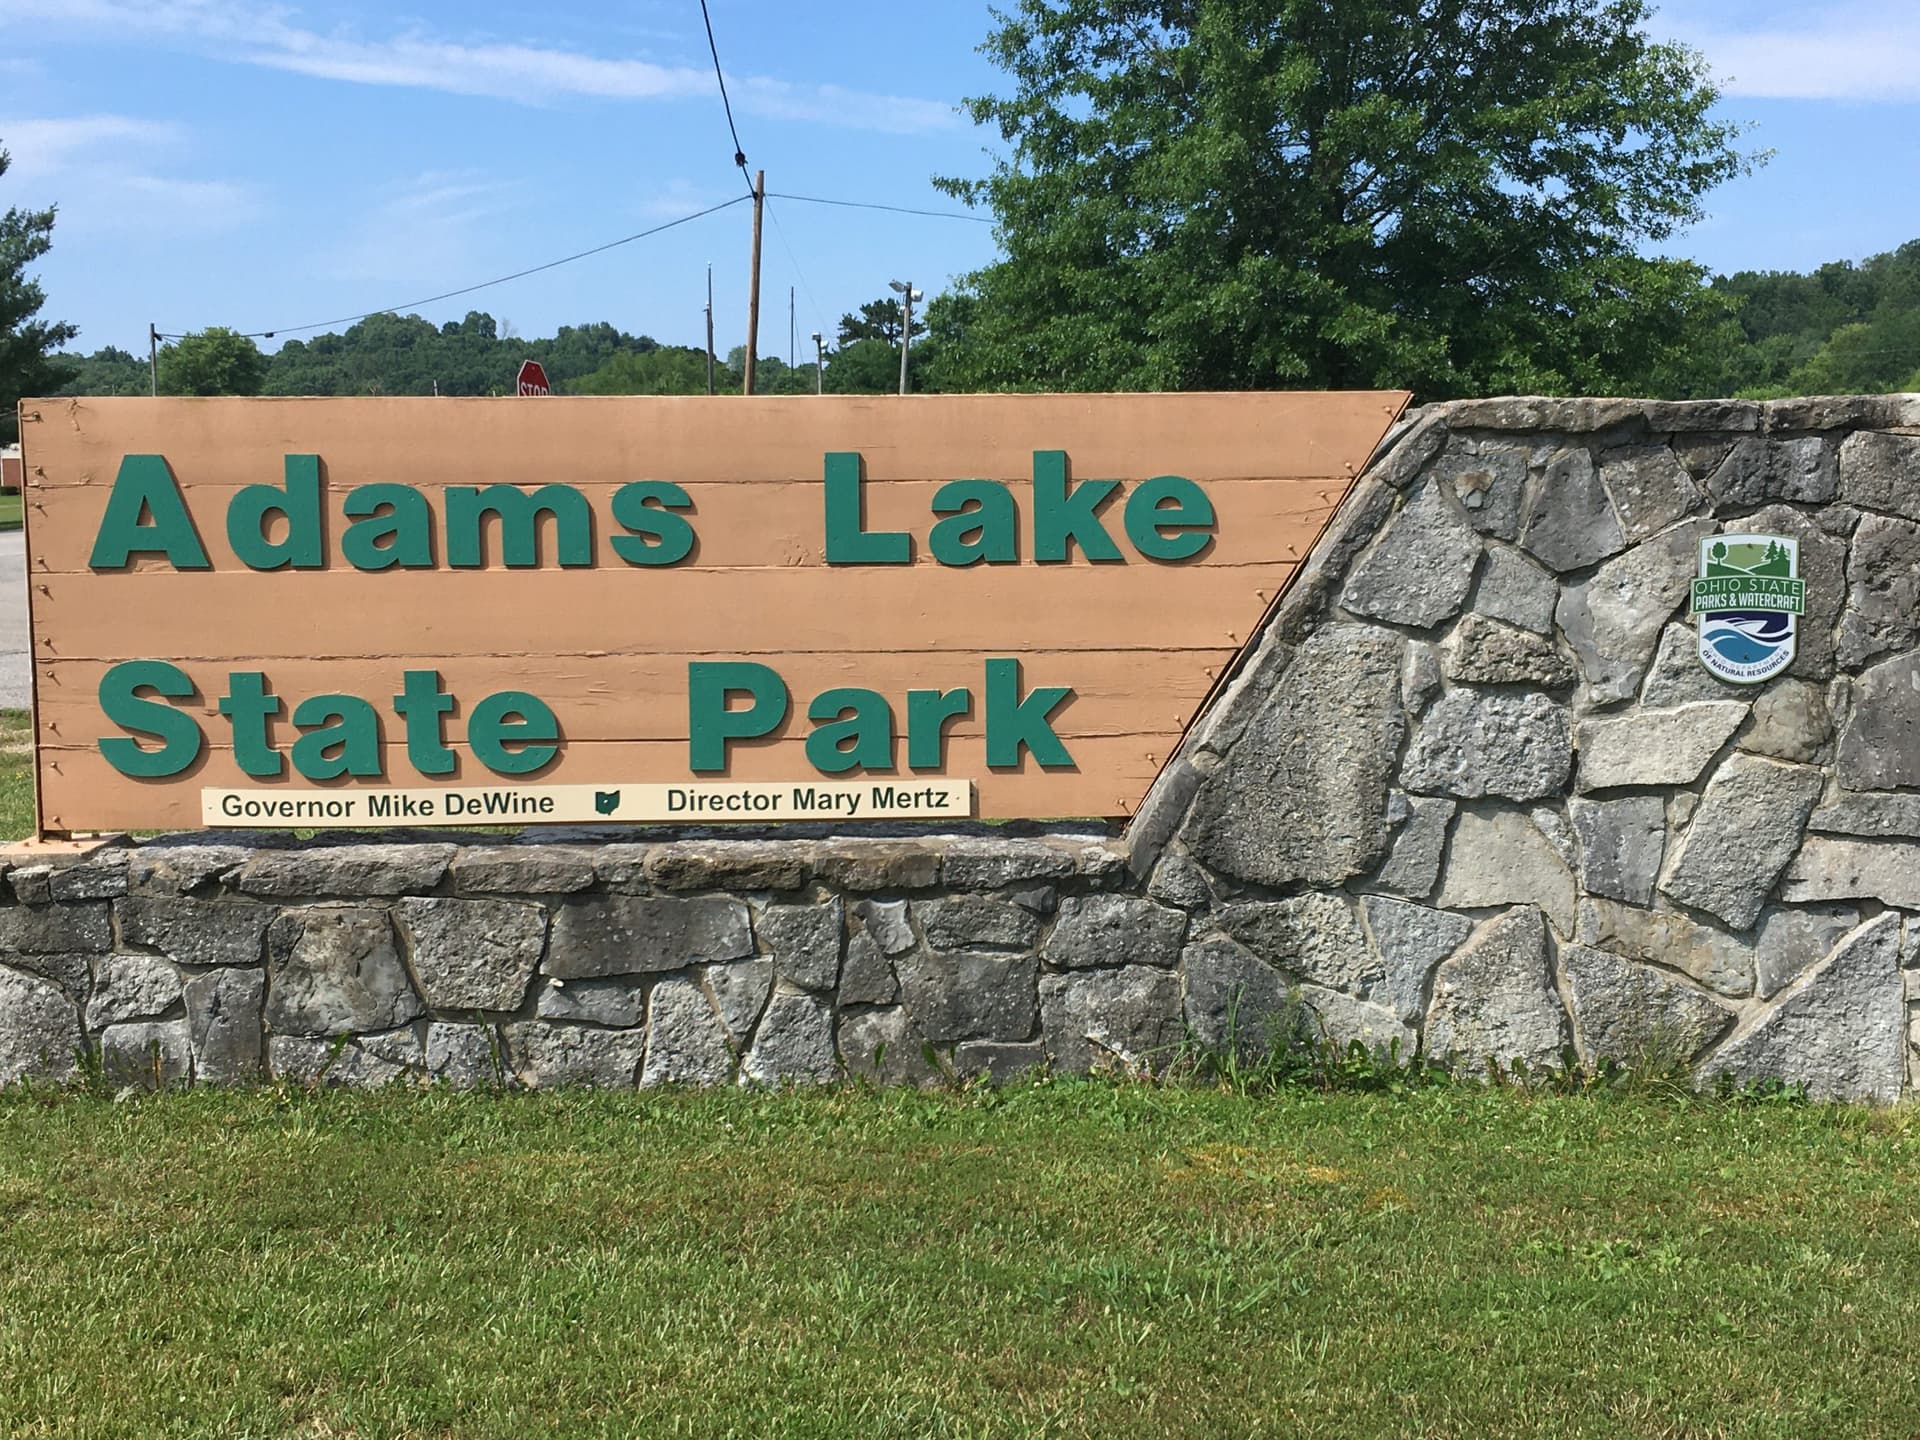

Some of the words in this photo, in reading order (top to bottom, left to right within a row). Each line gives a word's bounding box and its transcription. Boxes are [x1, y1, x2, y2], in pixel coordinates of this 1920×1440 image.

[89, 453, 695, 570] Adams
[824, 449, 1214, 567] Lake
[1695, 578, 1741, 594] OHIO
[1749, 578, 1800, 595] STATE
[1695, 594, 1727, 611] PARKS
[1729, 592, 1737, 607] &
[1738, 593, 1801, 611] WATERCRAFT
[1702, 649, 1713, 660] OF
[1710, 658, 1745, 677] NATURAL
[1747, 650, 1790, 677] RESOURCES
[98, 659, 560, 780] State
[688, 657, 1077, 772] Park
[221, 793, 355, 818] Governor
[368, 793, 435, 818] Mike
[445, 792, 555, 816] DeWine
[667, 788, 782, 812] Director
[793, 788, 861, 816] Mary
[872, 786, 950, 809] Mertz
